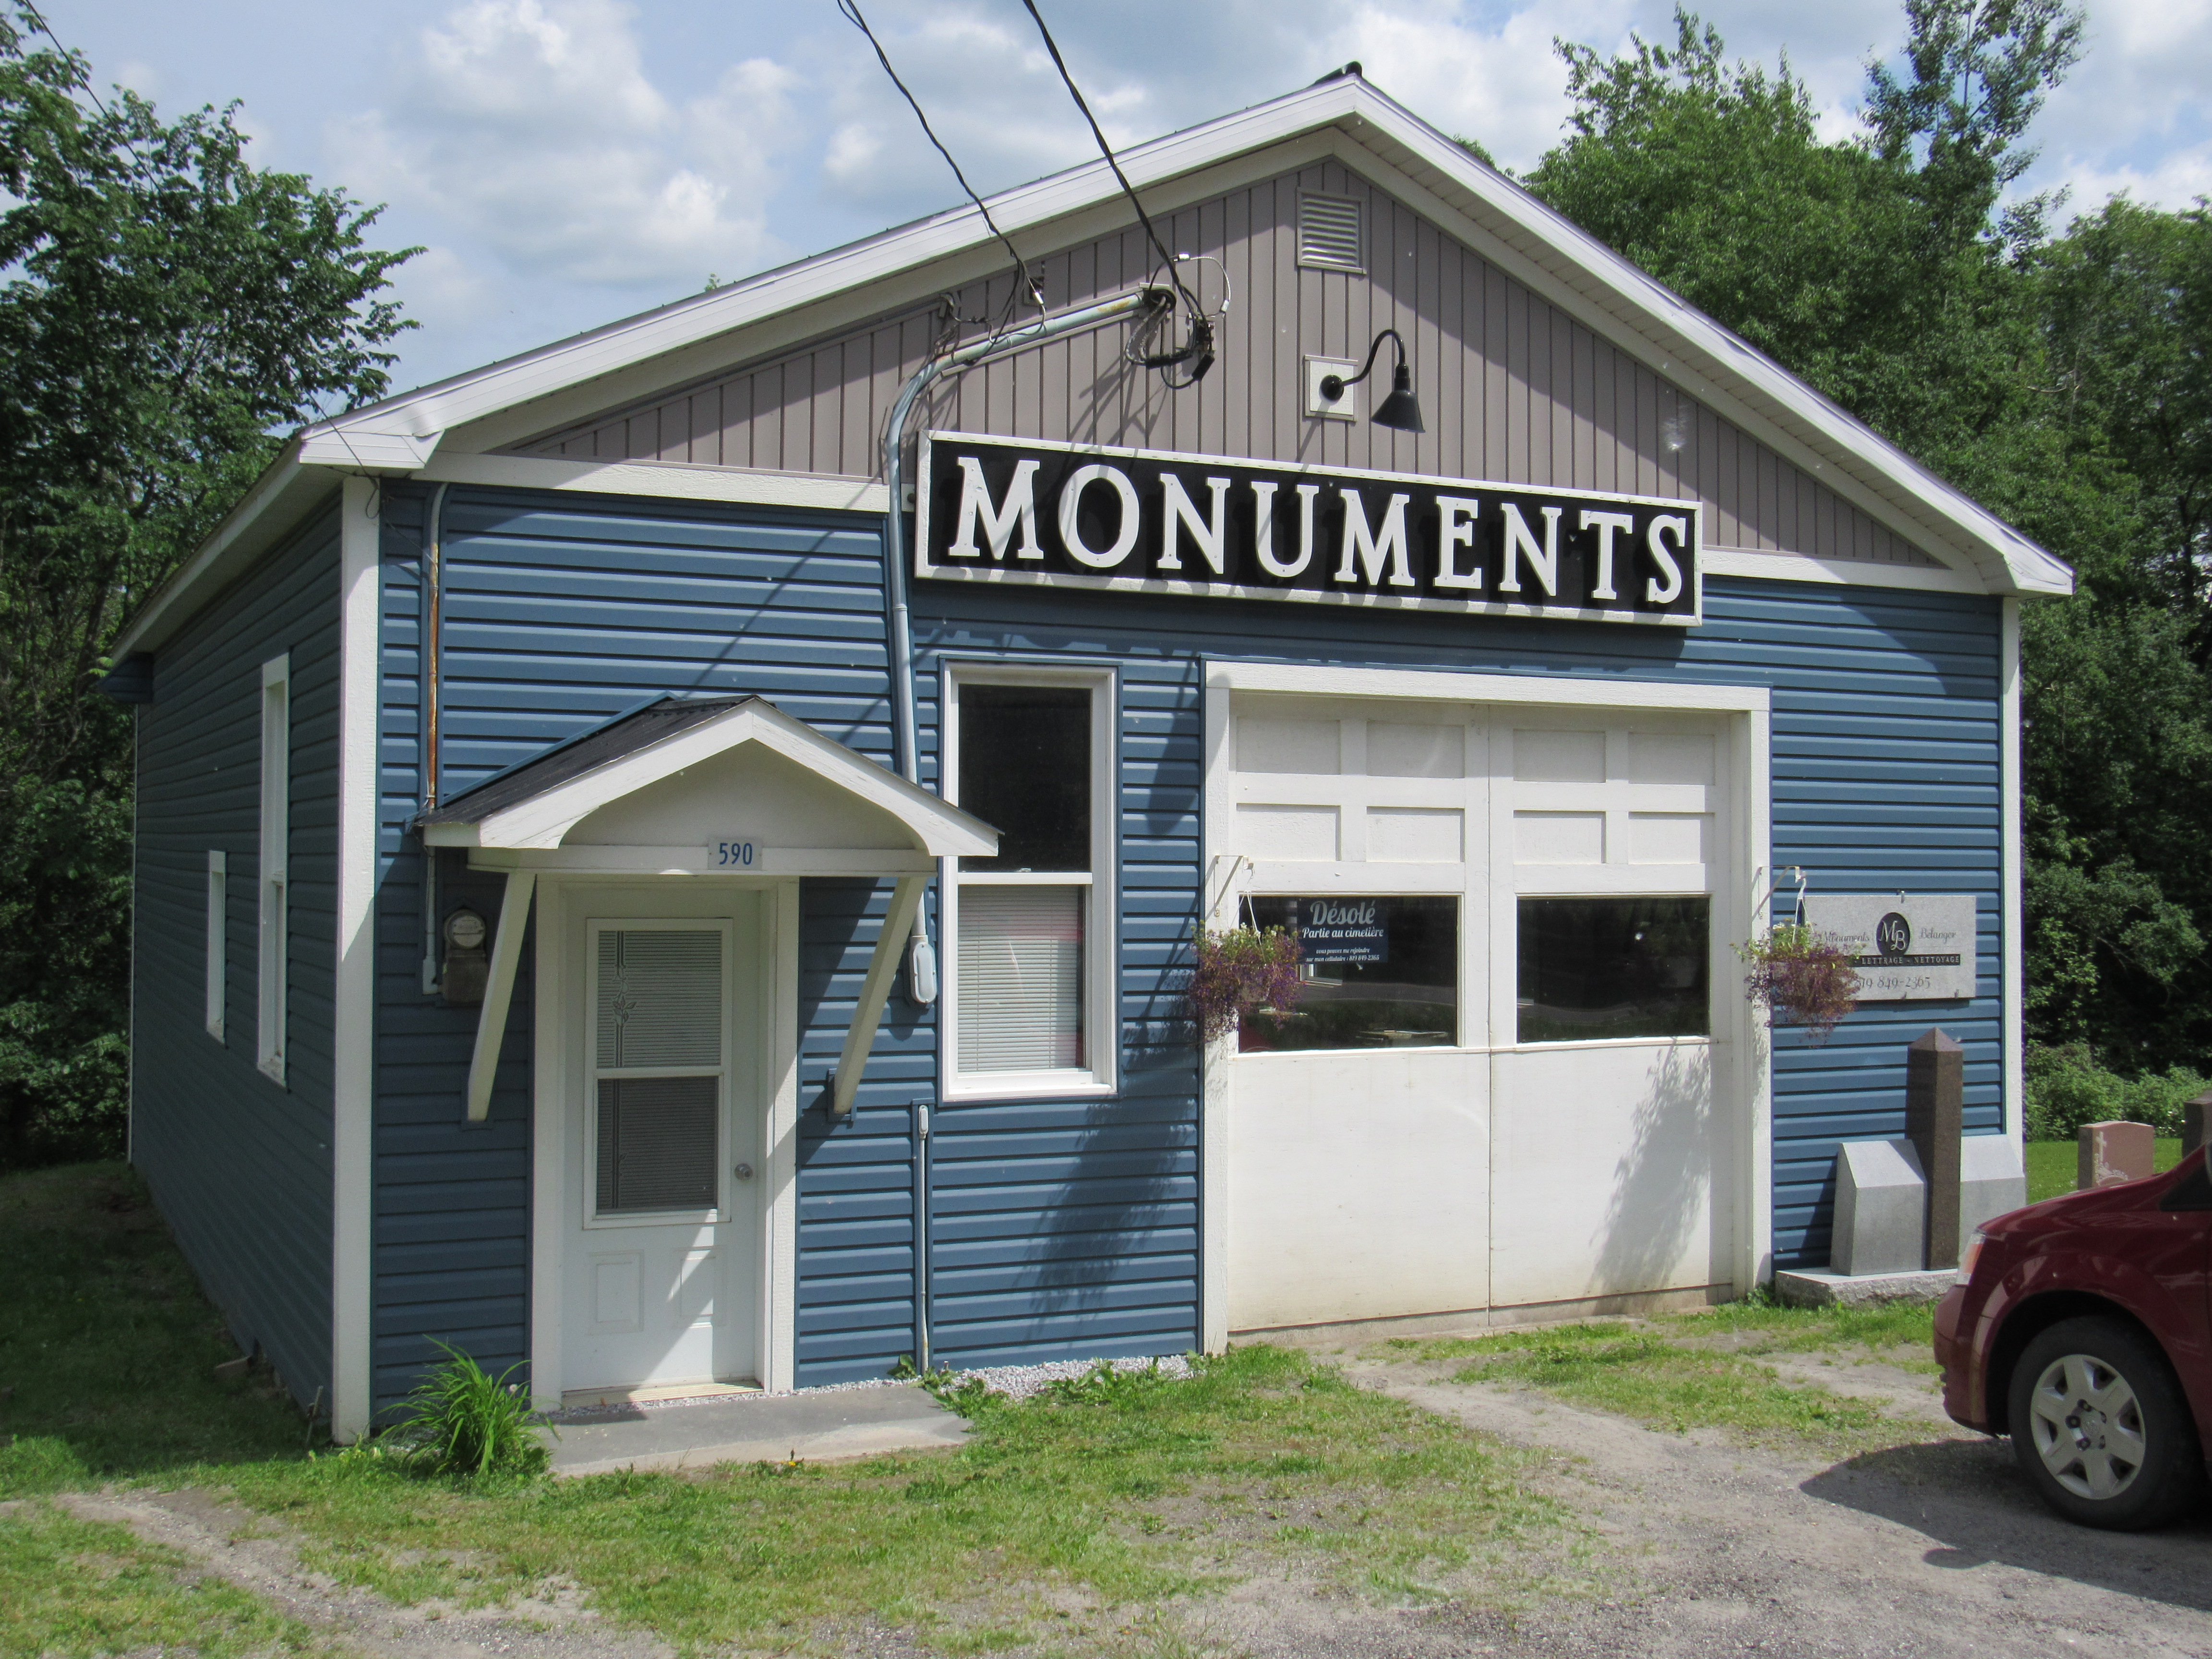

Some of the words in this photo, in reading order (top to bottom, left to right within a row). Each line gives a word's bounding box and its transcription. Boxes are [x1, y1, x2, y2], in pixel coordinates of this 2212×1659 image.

[949, 456, 1686, 602] MONUMENTS
[720, 843, 752, 865] 590
[1310, 900, 1376, 925] Désolé
[1302, 927, 1329, 938] Partie
[1332, 929, 1344, 938] au
[1345, 926, 1384, 938] cimetière
[1877, 975, 1930, 989] 849-2365
